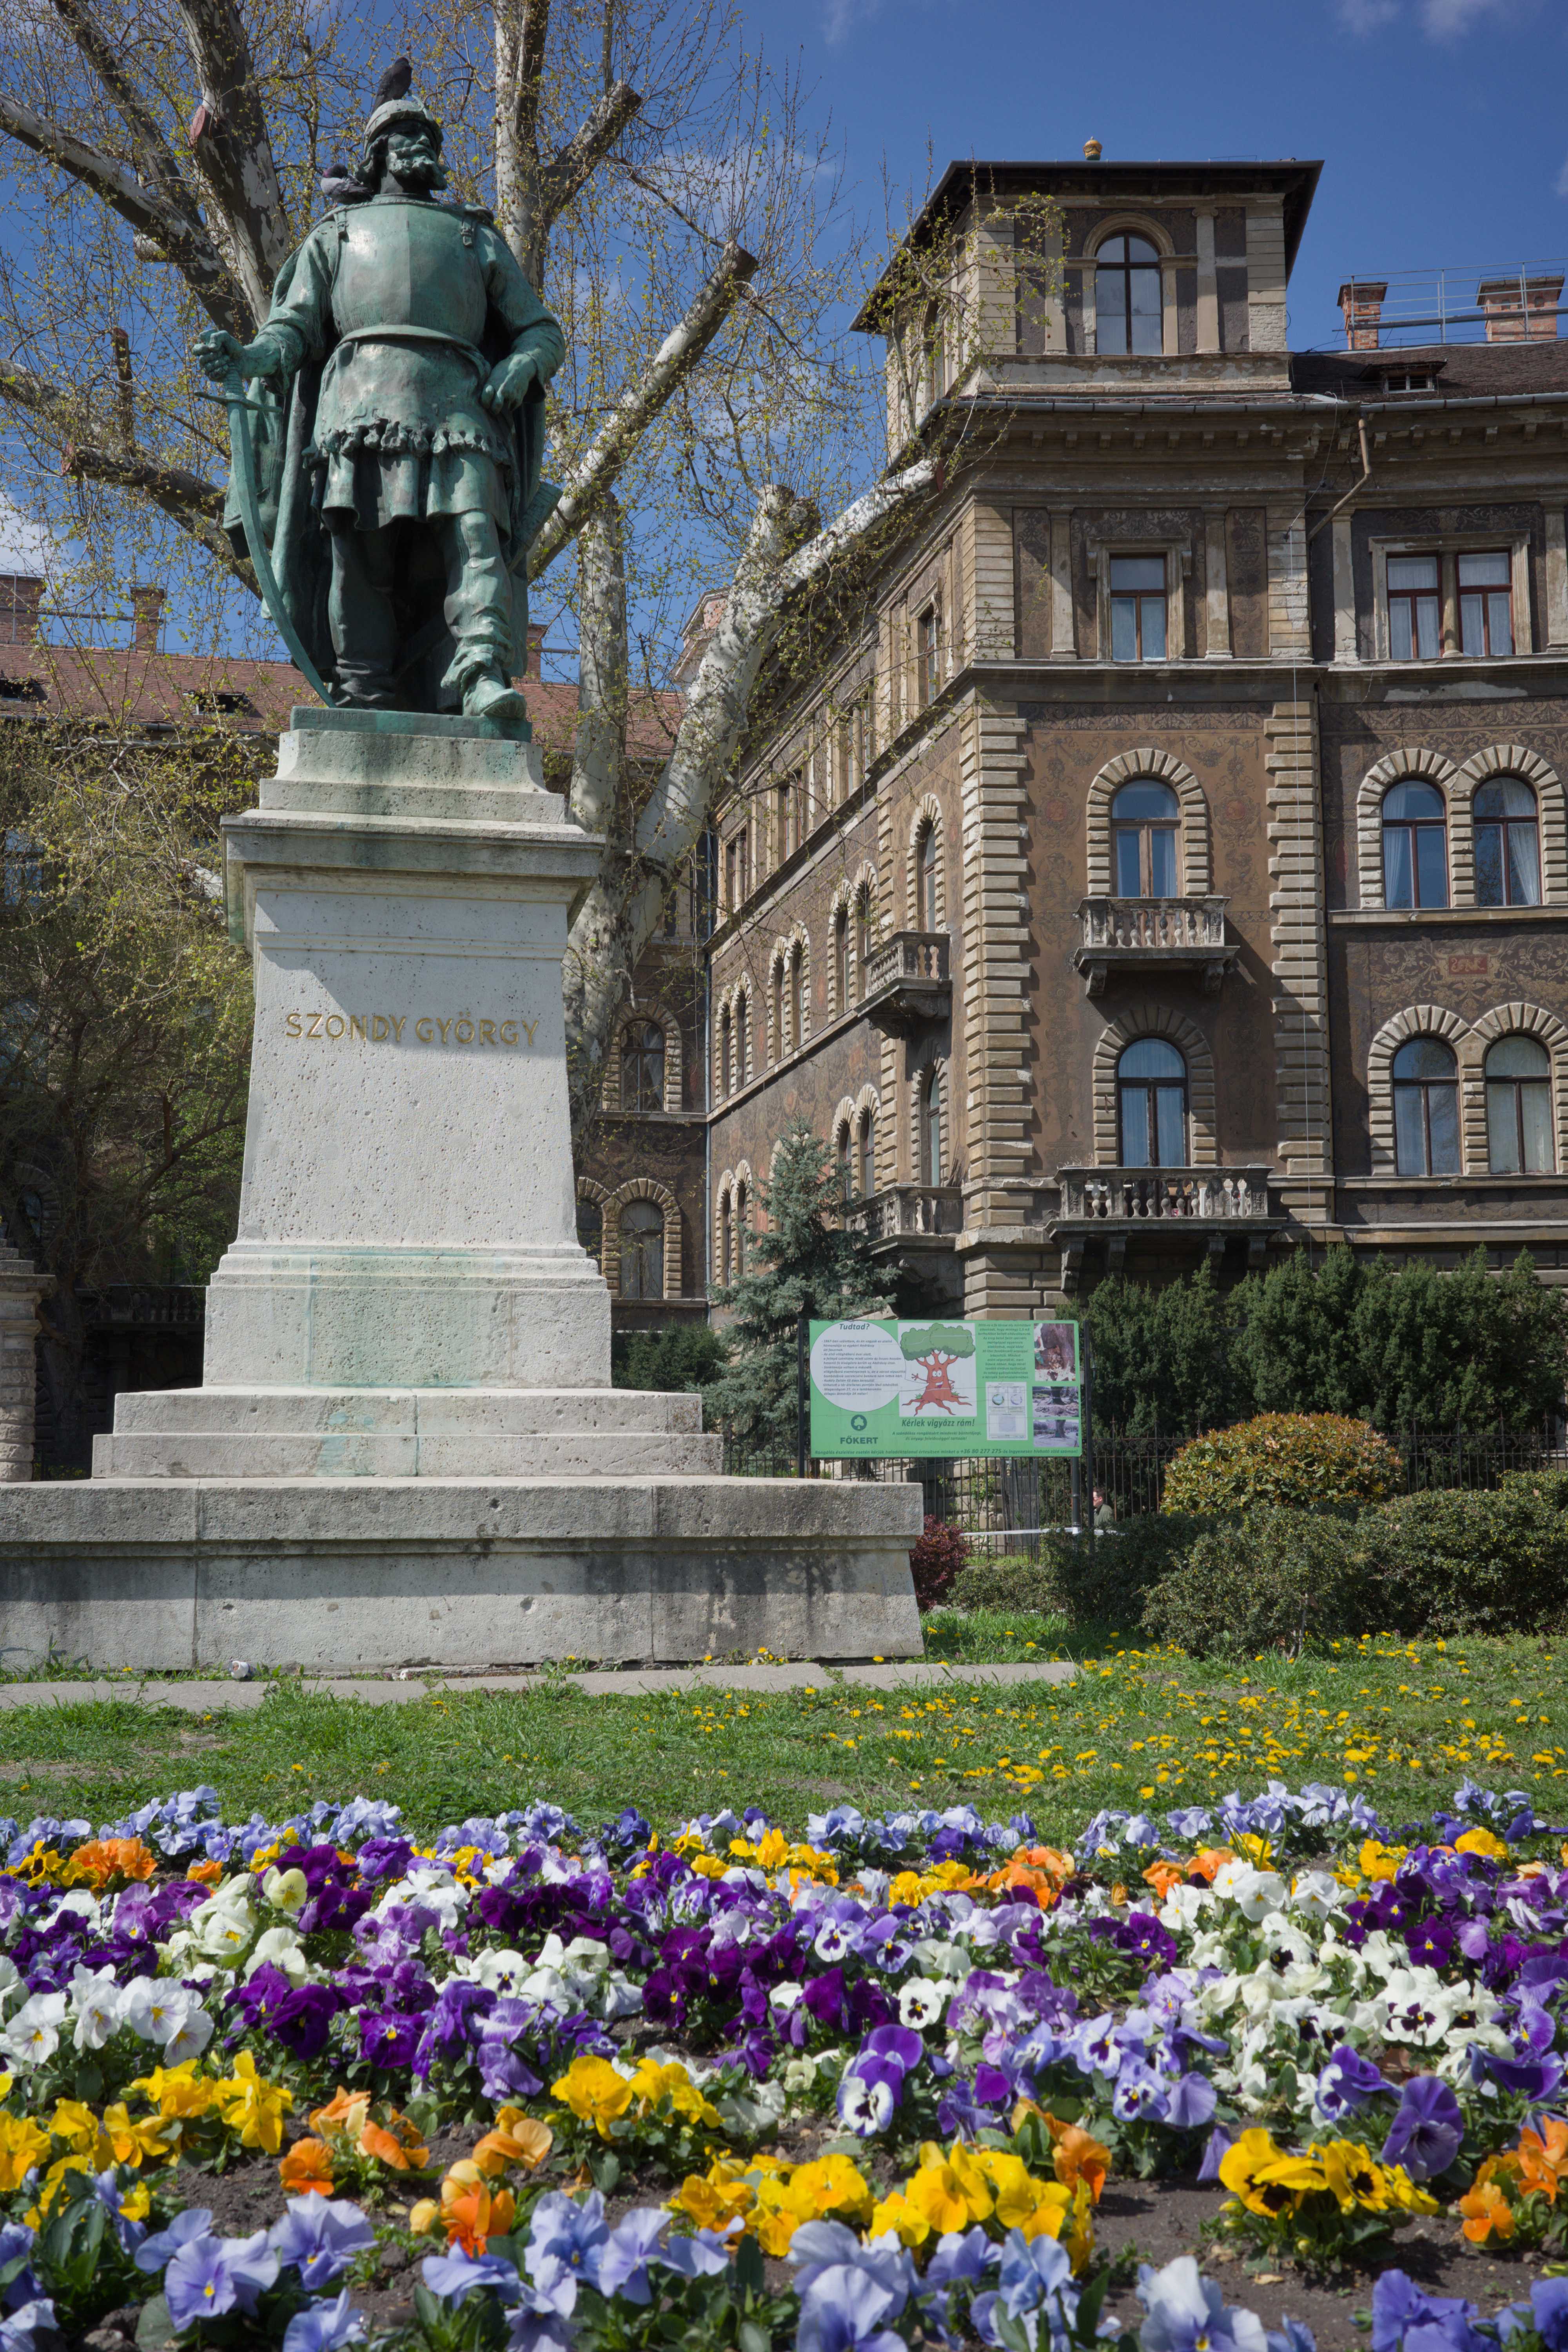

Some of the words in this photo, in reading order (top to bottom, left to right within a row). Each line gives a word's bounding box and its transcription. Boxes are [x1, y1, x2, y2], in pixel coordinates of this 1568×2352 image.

[286, 1013, 407, 1042] SZONDY
[416, 1012, 539, 1046] GYÖRGY
[927, 1419, 955, 1428] vigyázz
[840, 1436, 878, 1444] FŐKERT
